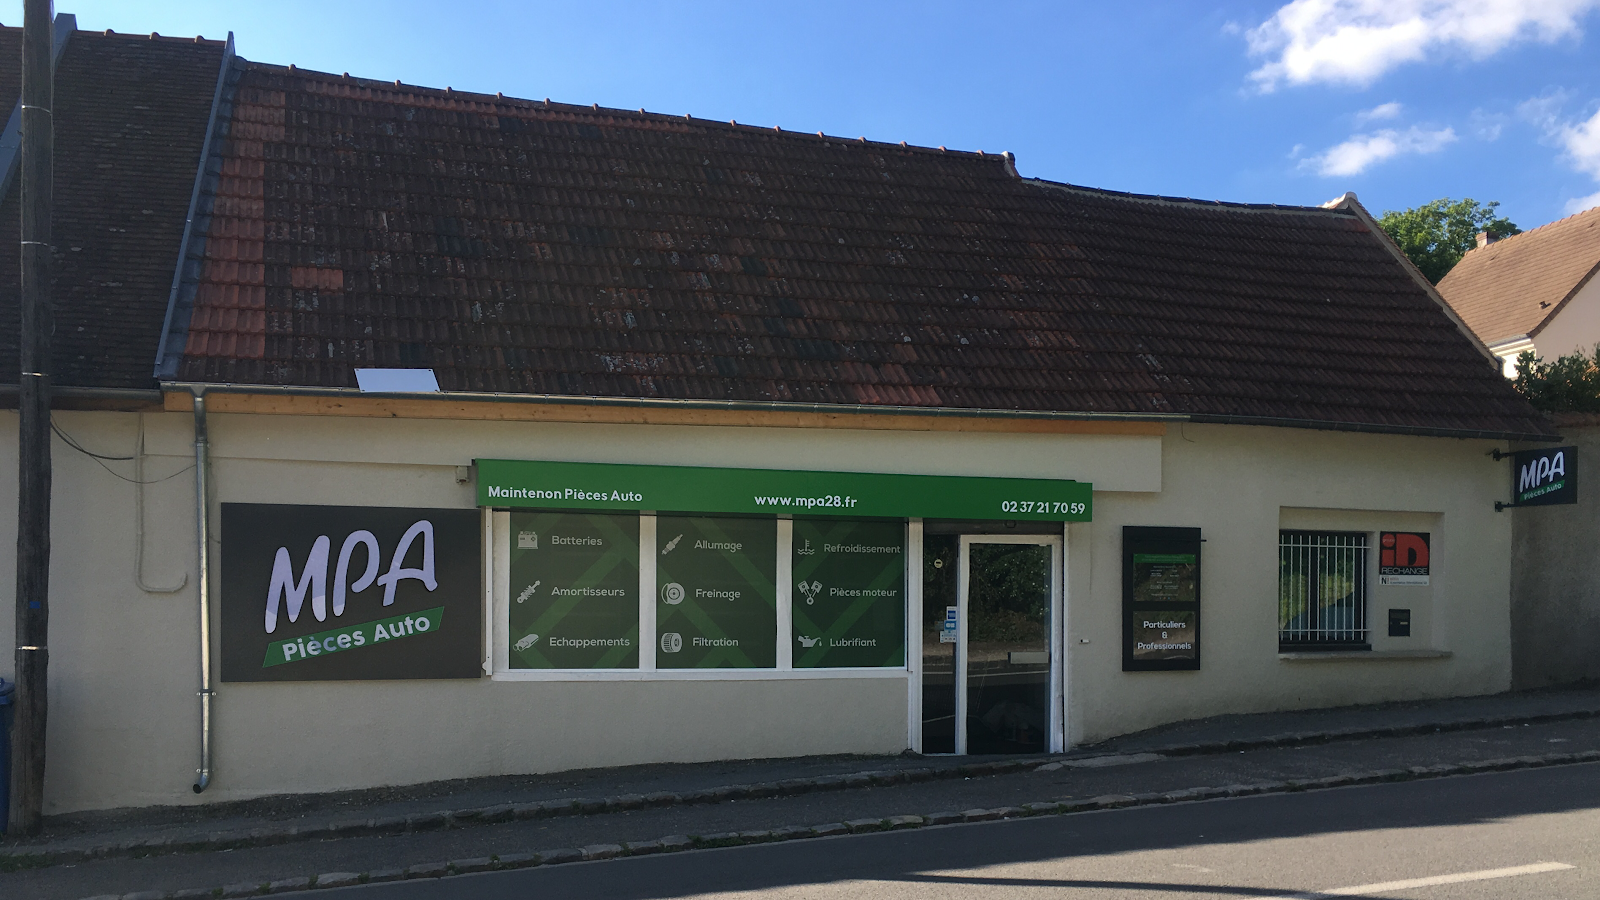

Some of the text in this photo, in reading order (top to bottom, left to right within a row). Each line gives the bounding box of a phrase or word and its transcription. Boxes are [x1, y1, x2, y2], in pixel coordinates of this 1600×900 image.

[1519, 451, 1565, 493] MPA
[488, 485, 643, 502] Maintenon Pièces Auto
[1523, 483, 1562, 500] Pièces Auto
[754, 495, 858, 509] www.mpa28.fr
[1001, 500, 1086, 515] 02 37 21 70 59
[551, 535, 603, 546] Batteries
[694, 539, 743, 553] Allumage
[823, 543, 901, 554] Refroidissement
[264, 519, 438, 634] MPA
[1381, 567, 1428, 575] RECHANGE
[551, 586, 625, 597] Amortisseurs
[695, 588, 741, 601] Freinage
[829, 586, 897, 597] Pièces moteur
[1143, 620, 1186, 629] Particuliers
[282, 615, 431, 662] Pièces Auto
[549, 637, 630, 648] Echappements
[692, 637, 739, 647] Filtration
[829, 637, 877, 647] Lubrifiant
[1137, 642, 1192, 650] Professionnels
